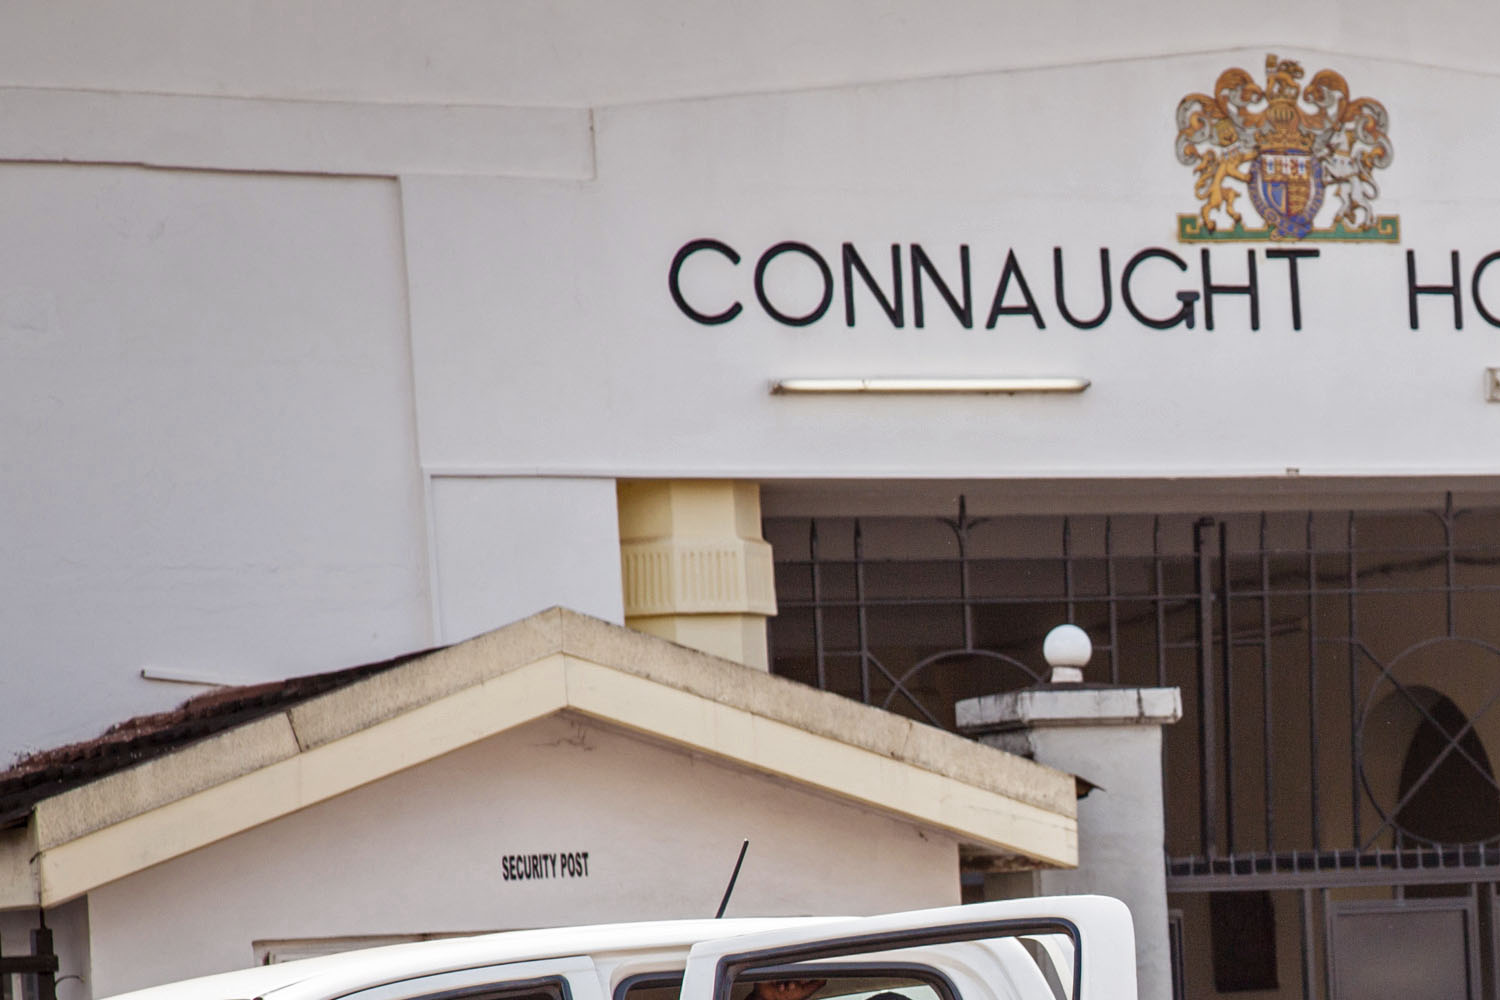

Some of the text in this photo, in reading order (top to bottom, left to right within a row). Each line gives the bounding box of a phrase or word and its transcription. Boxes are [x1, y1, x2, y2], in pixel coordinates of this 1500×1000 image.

[668, 238, 1320, 332] CONNAUGHT
[502, 851, 589, 881] SECURITY POST
